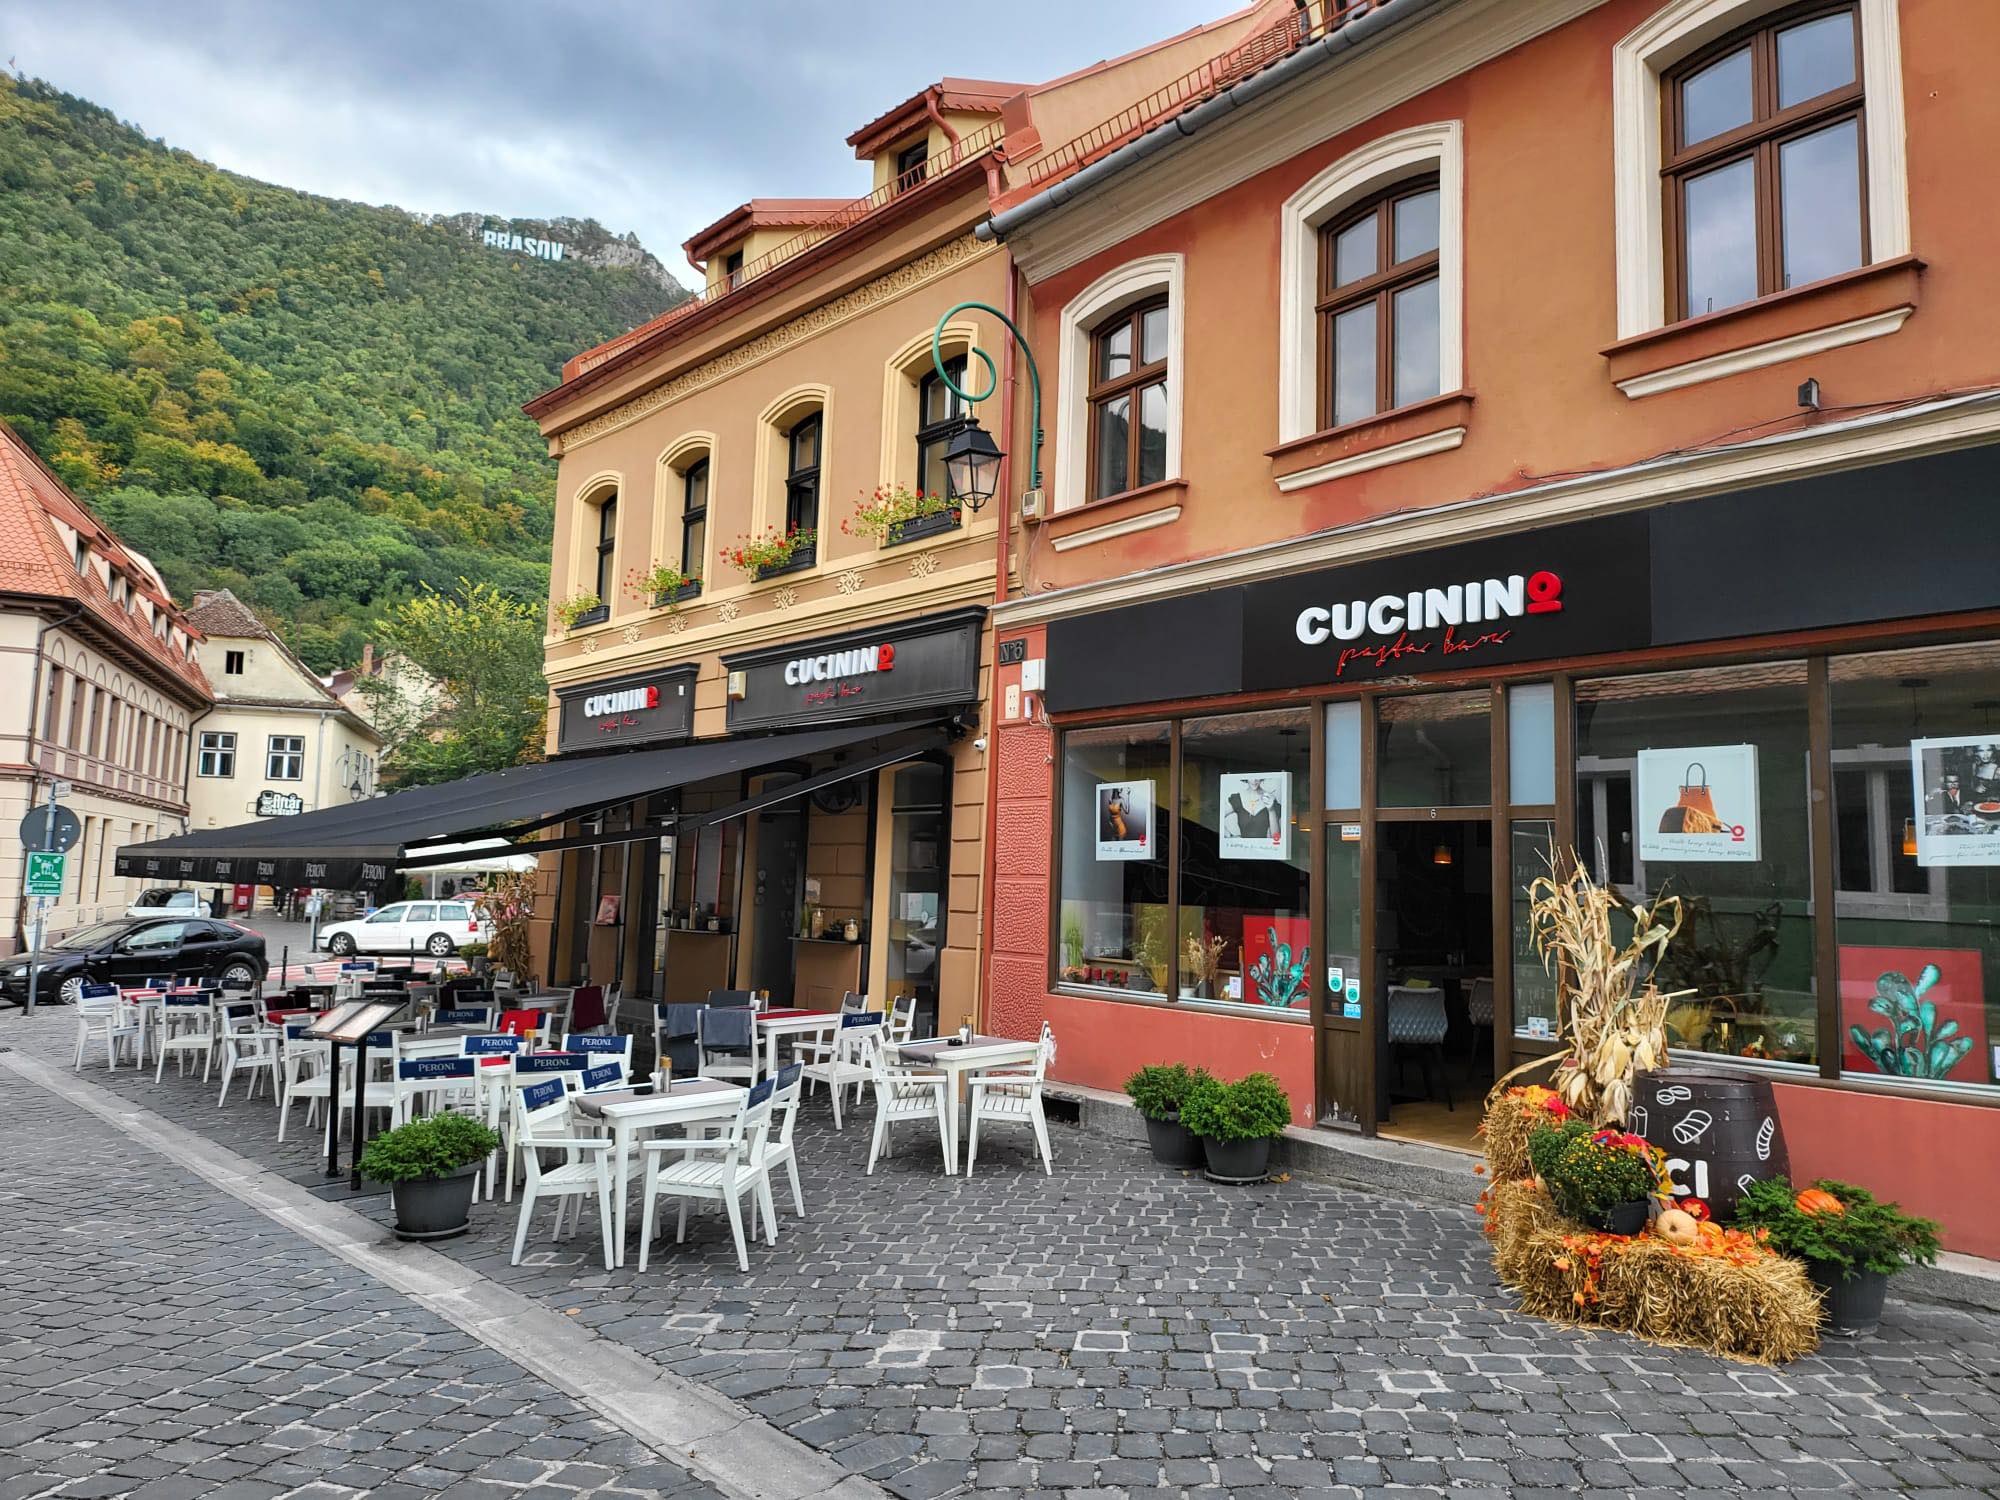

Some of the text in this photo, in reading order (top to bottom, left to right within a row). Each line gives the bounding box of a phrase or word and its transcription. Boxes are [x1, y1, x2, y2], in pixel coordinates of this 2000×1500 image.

[484, 229, 564, 262] BRASOV
[1295, 570, 1563, 645] CUCININO
[1335, 625, 1512, 676] pasta bar
[784, 642, 895, 686] CUCININO
[584, 684, 659, 718] CUCININO
[1430, 808, 1437, 819] 6
[305, 863, 327, 878] PERONI
[361, 863, 387, 880] PERONI
[448, 1010, 474, 1018] PERONI
[481, 1038, 513, 1047] PERONI
[581, 1037, 613, 1046] PERONI
[418, 1062, 457, 1073] PERONI
[534, 1058, 571, 1068] PERONI
[591, 1067, 613, 1081] PERONI
[533, 1084, 554, 1099] PERONI
